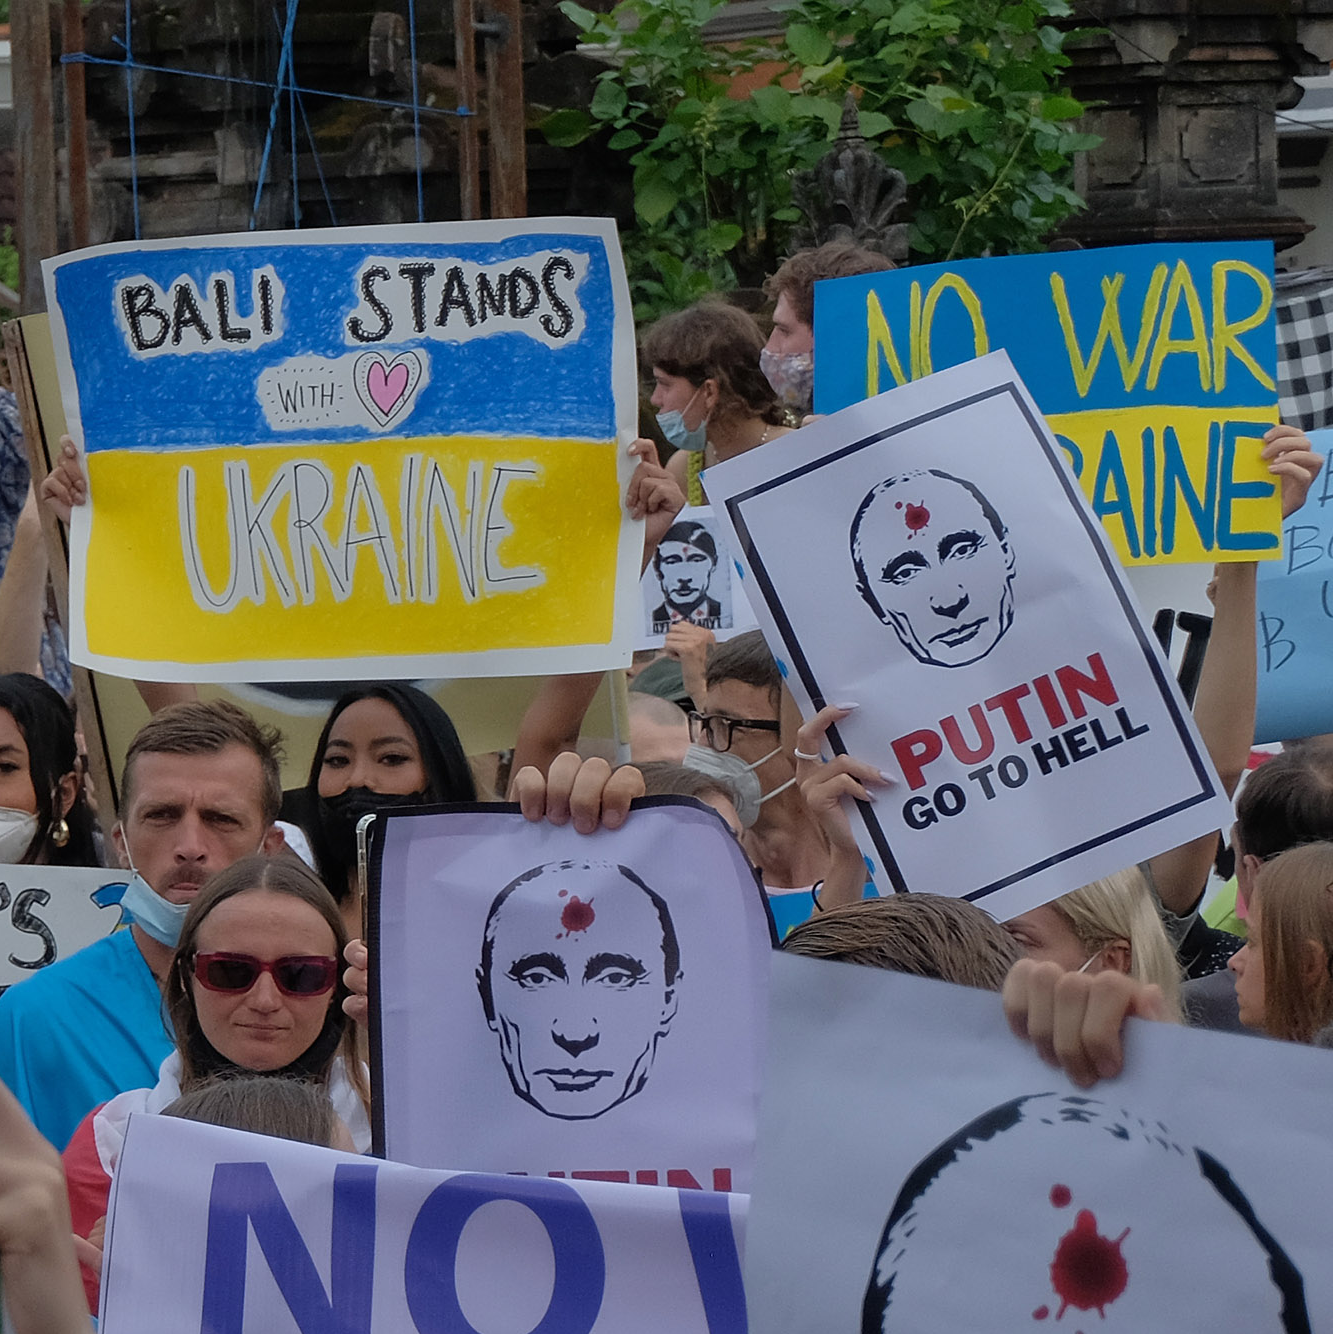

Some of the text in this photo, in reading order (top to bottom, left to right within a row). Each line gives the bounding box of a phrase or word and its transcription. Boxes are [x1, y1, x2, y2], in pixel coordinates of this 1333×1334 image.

[121, 255, 576, 352] BALI STANDS
[867, 258, 1276, 398] NO WAR
[277, 378, 336, 412] WITH
[186, 457, 538, 607] UKRAINE
[1073, 421, 1280, 559] AINE
[890, 652, 1120, 791] PUTIN
[902, 706, 1150, 830] GO TO HELL
